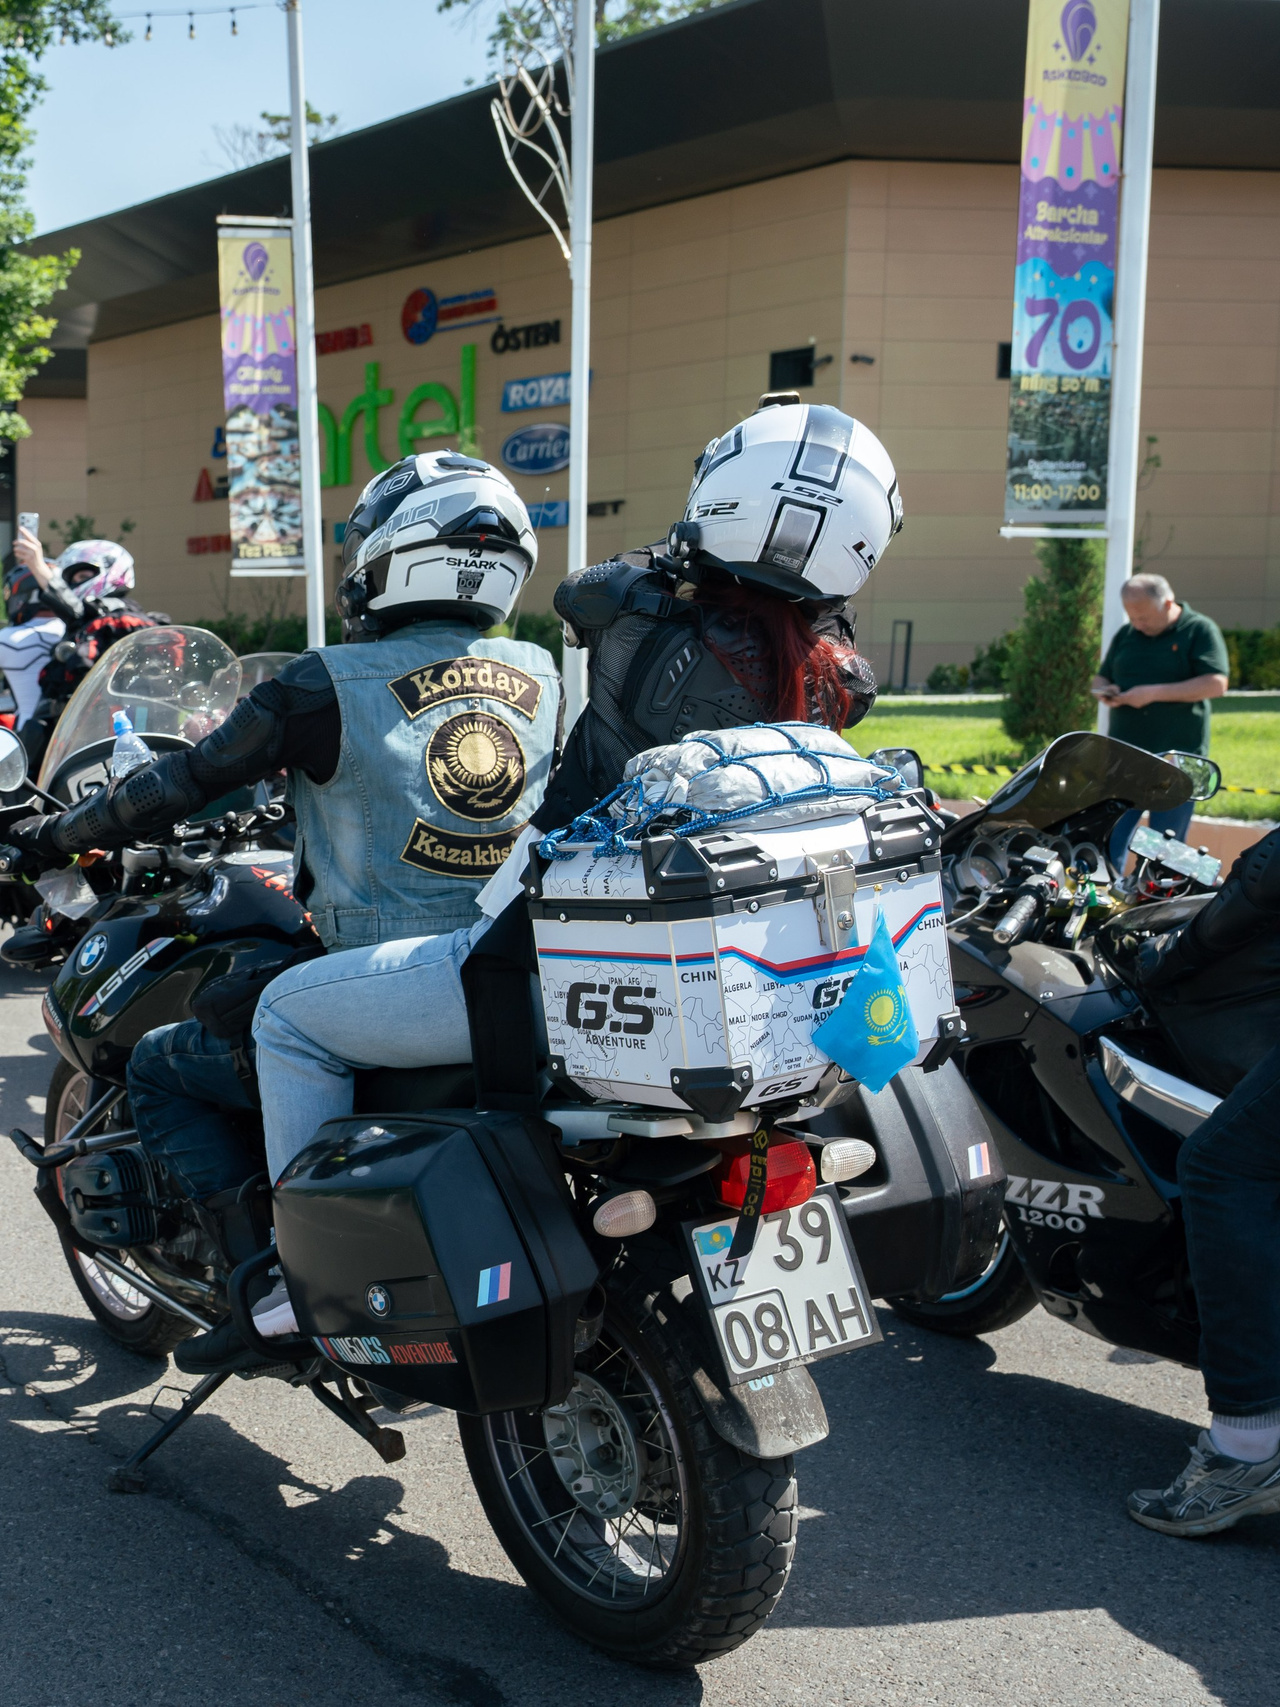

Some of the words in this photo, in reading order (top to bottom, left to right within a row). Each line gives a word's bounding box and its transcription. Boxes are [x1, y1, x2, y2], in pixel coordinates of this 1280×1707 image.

[1036, 201, 1099, 226] Barcha
[1025, 297, 1102, 370] 70
[770, 481, 844, 507] LS2
[1013, 484, 1101, 500] 11:00-17:00
[445, 556, 499, 571] SHARK
[458, 577, 480, 588] DOT
[410, 663, 529, 702] Korday
[413, 830, 518, 867] Kazakhs
[604, 869, 614, 895] MALI
[95, 947, 151, 1005] GS
[566, 981, 657, 1035] GS
[728, 1015, 746, 1025] MALI
[793, 1014, 813, 1023] SUDAN
[586, 1034, 647, 1050] ADVENTURE
[758, 1076, 809, 1098] GS
[1004, 1174, 1106, 1219] ZZR
[1018, 1206, 1086, 1234] 1200
[763, 1202, 832, 1271] 39
[707, 1259, 745, 1292] KZ
[724, 1302, 790, 1369] 08
[805, 1287, 869, 1350] AH
[389, 1341, 457, 1365] ADVENTURE
